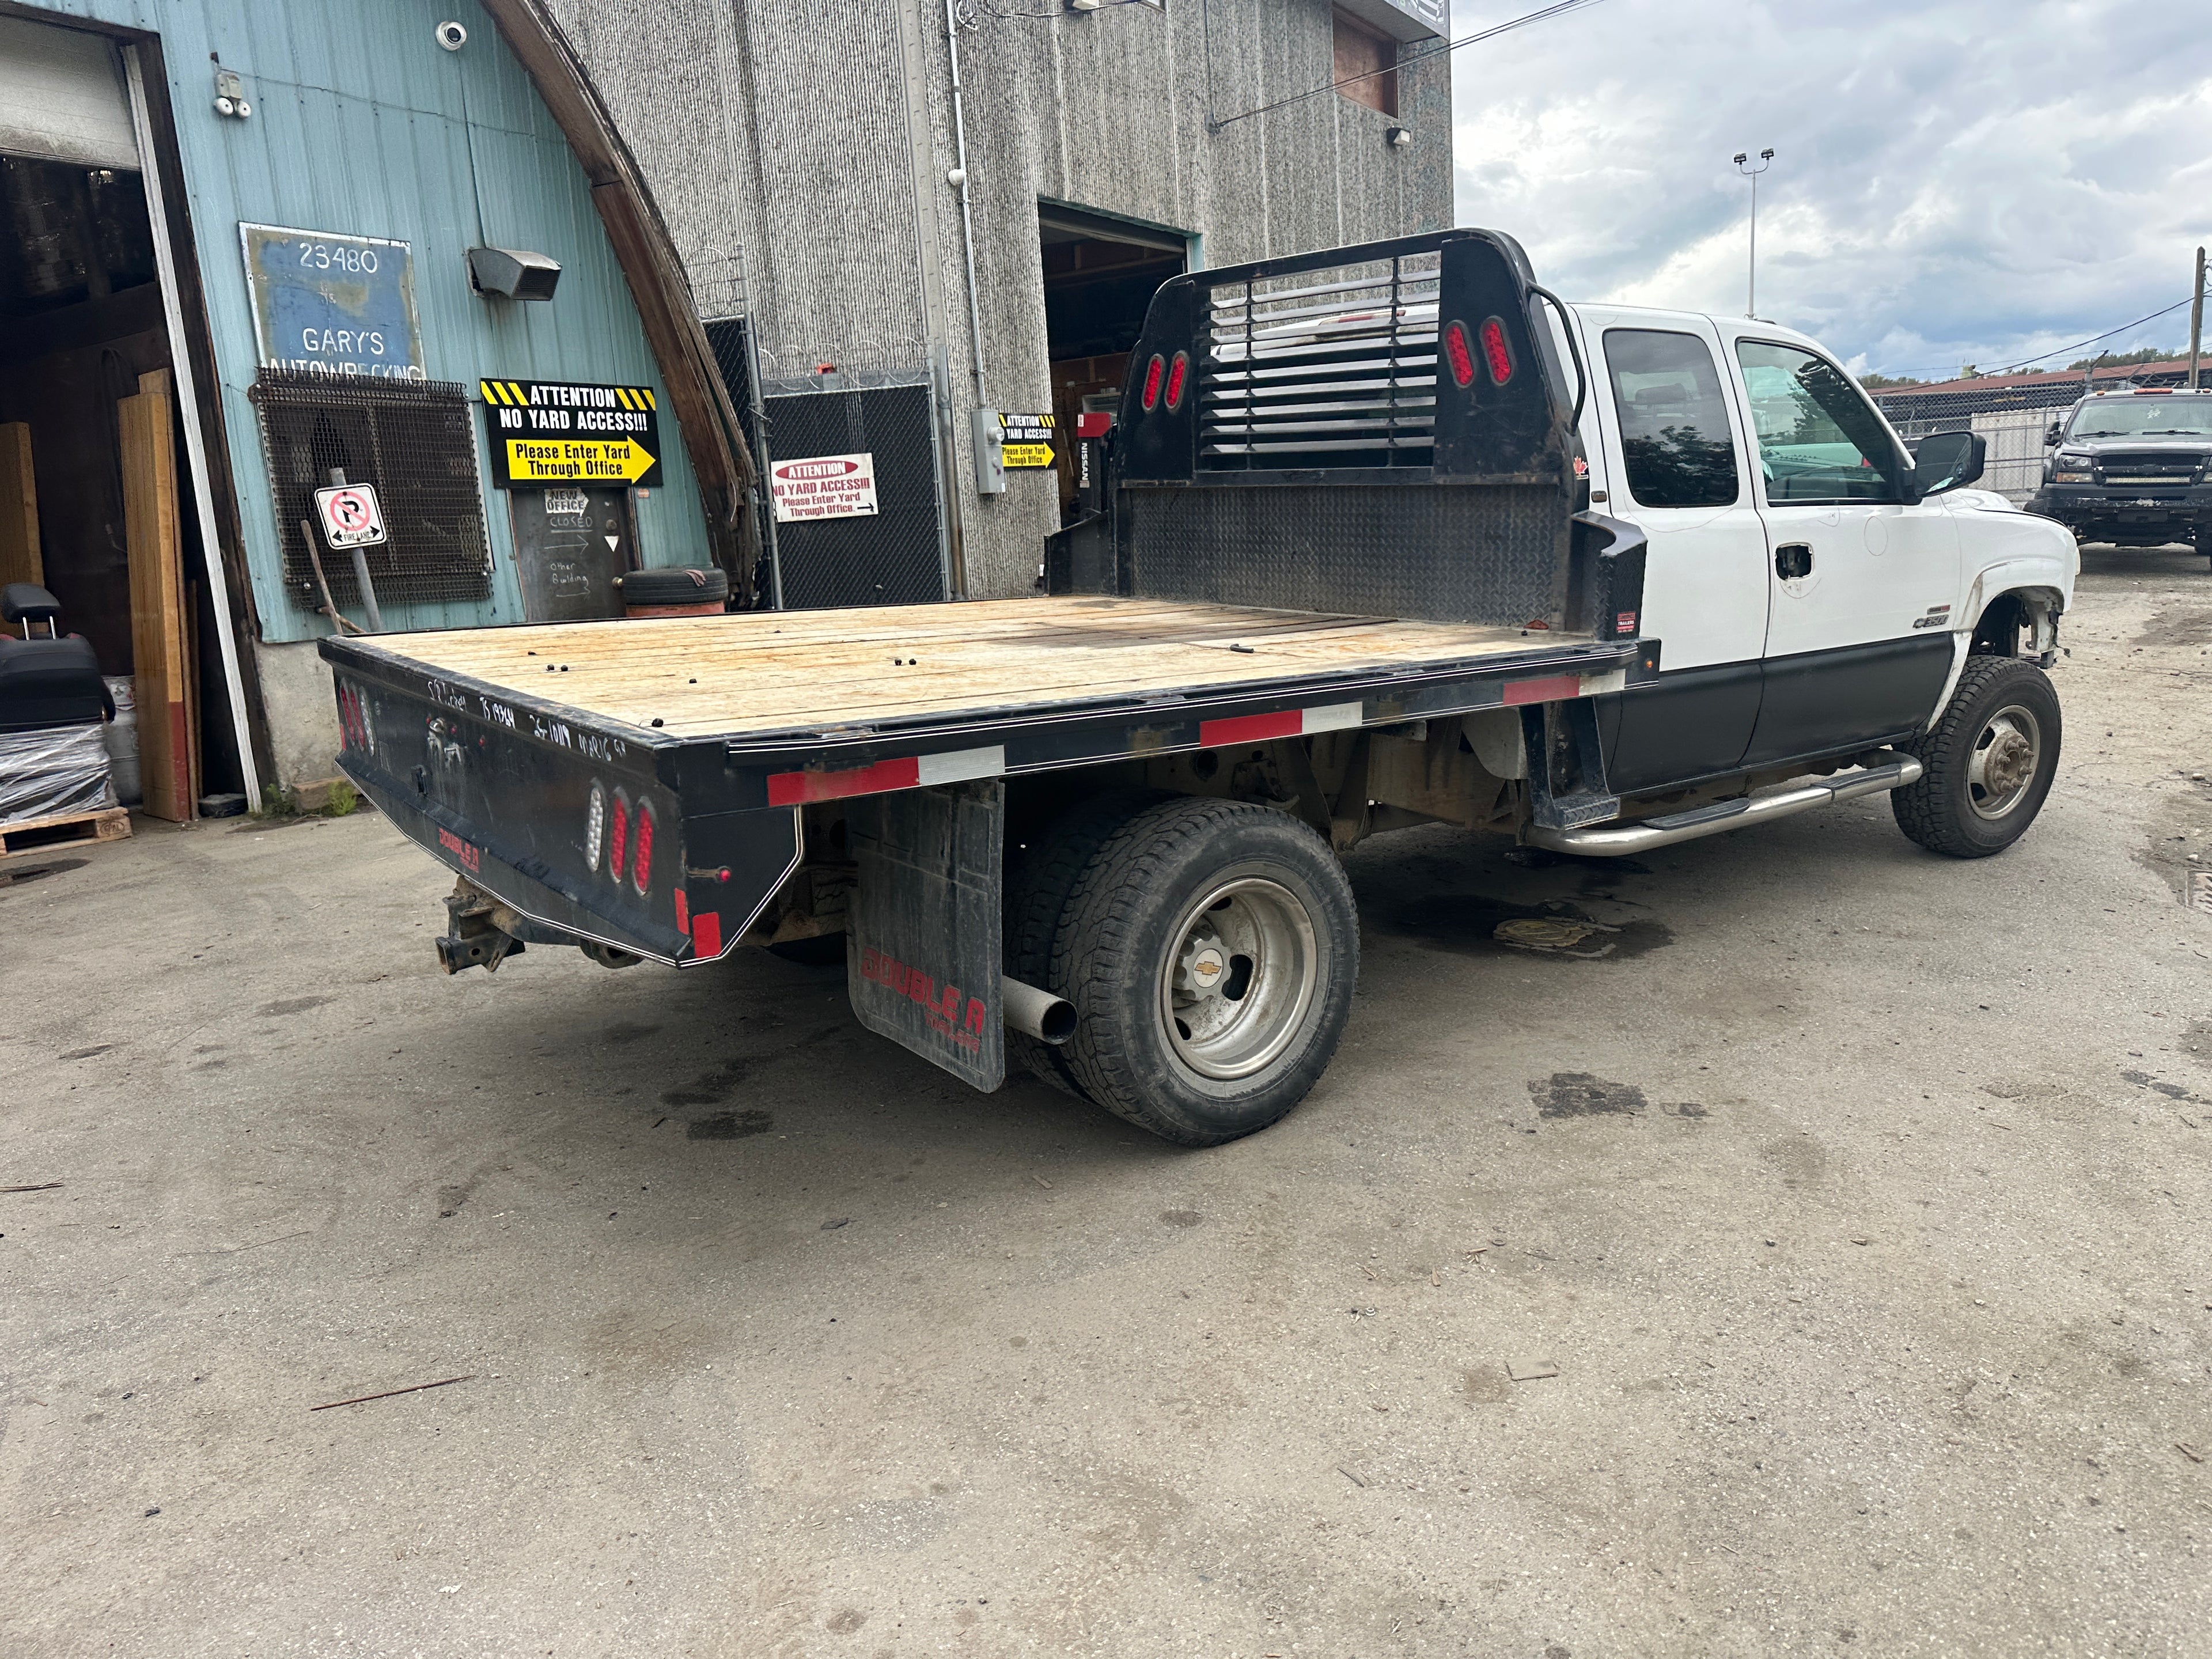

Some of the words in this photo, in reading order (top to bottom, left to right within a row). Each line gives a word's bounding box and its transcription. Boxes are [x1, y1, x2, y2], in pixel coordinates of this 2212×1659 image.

[299, 242, 378, 274] 23480
[302, 327, 384, 355] GARY'S
[531, 385, 616, 408] ATTENTION
[499, 408, 522, 428] NO
[528, 410, 570, 429] YARD
[577, 410, 647, 431] ACCESS!!!
[1007, 415, 1040, 427] ATTENTION
[1006, 428, 1022, 440] YARD
[1024, 428, 1052, 440] ACCESS!!!
[515, 443, 559, 459] Please
[565, 444, 597, 459] Enter
[603, 444, 631, 460] Yard
[1002, 446, 1018, 456] Please
[1020, 446, 1033, 454] Enter
[1035, 446, 1046, 455] Yard
[1006, 456, 1026, 465] Through
[1028, 456, 1043, 464] Office
[528, 460, 581, 478] Through
[586, 462, 623, 475] Office
[788, 462, 846, 479] ATTENTION
[551, 490, 577, 500] NEW
[772, 485, 785, 497] NO
[787, 482, 817, 495] YARD
[820, 478, 870, 493] ACCESS!!!
[547, 500, 585, 511] OFFICE
[782, 497, 810, 507] Please
[812, 495, 836, 505] Enter
[838, 492, 861, 502] Yard
[790, 507, 825, 517] Through
[827, 504, 853, 514] Office
[550, 516, 593, 528] CLOSED
[357, 532, 371, 540] LANE
[1927, 615, 1948, 626] 3500
[438, 827, 471, 860] DOUBLE
[861, 947, 961, 1021] DOUBLE
[965, 996, 985, 1035] A
